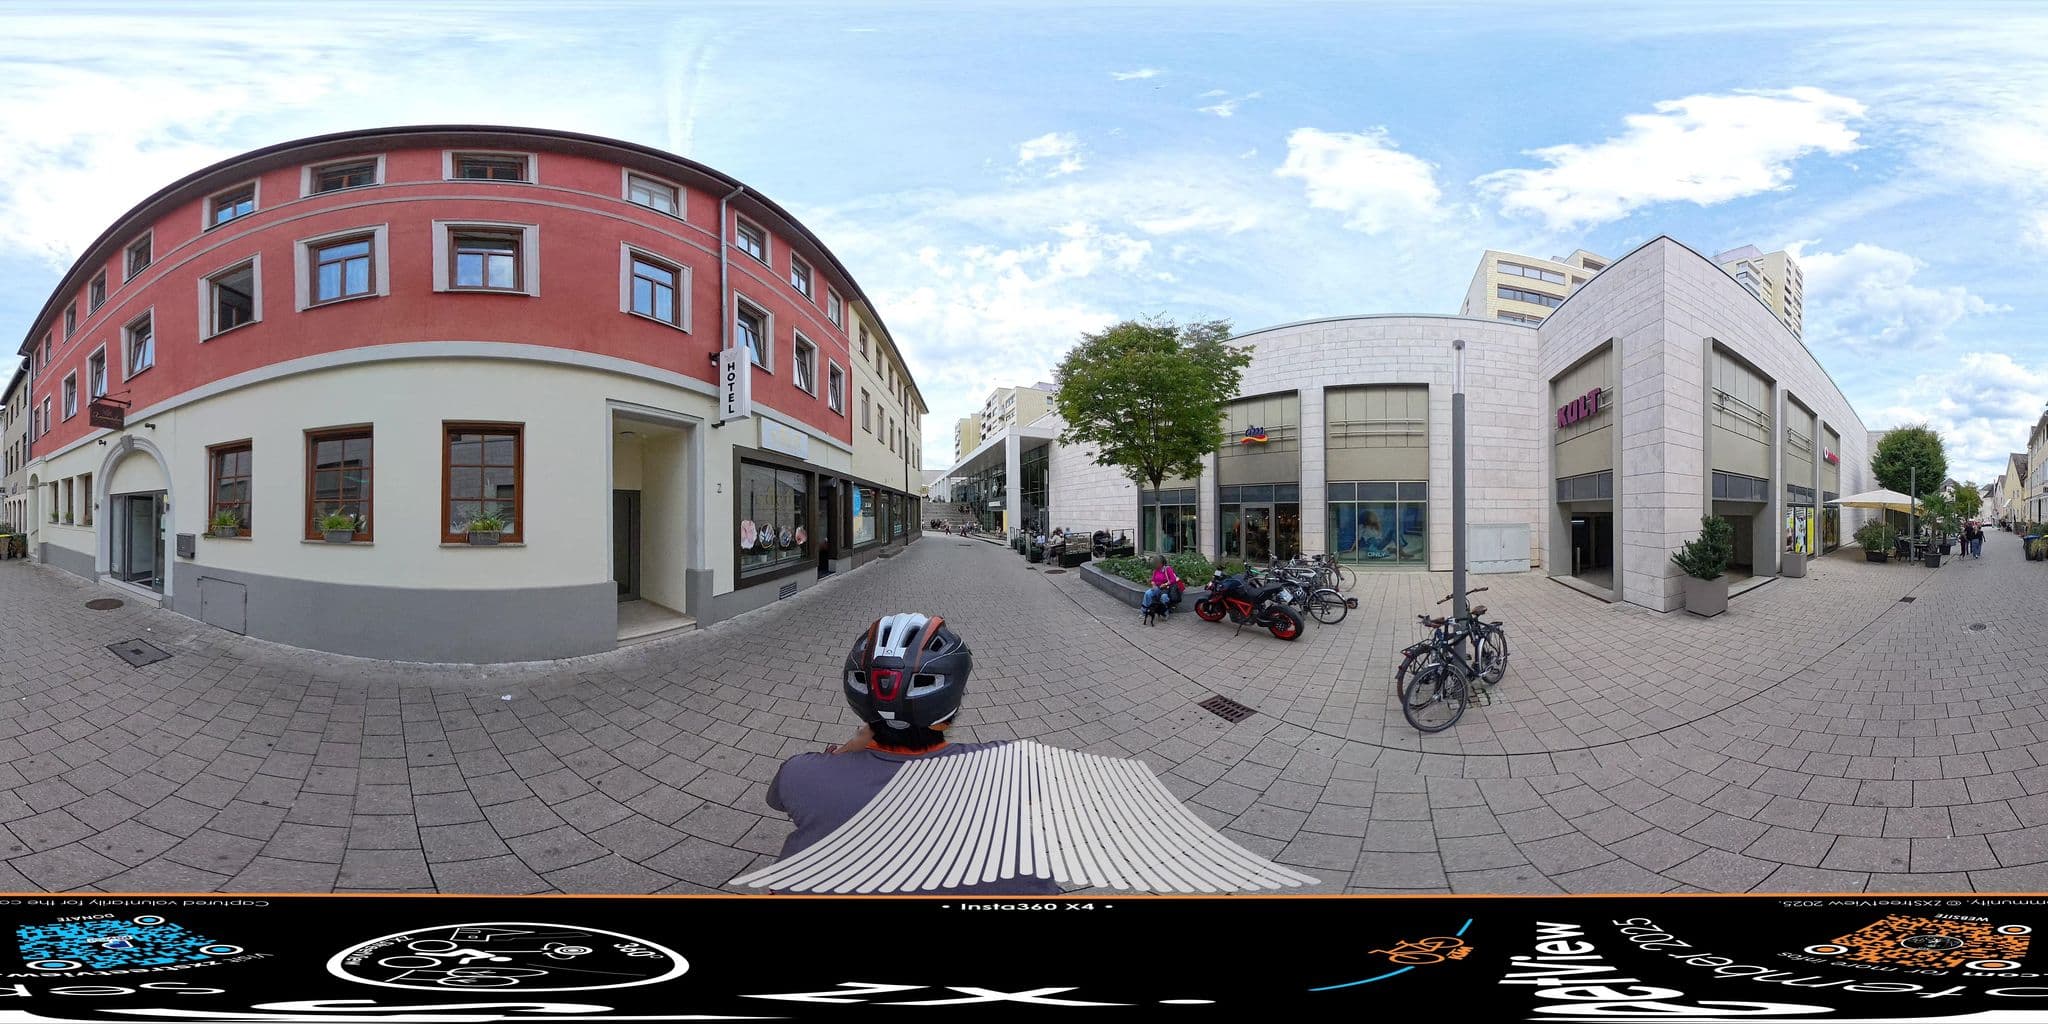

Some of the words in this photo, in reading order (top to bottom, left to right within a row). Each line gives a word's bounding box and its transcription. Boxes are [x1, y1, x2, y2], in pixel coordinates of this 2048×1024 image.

[727, 361, 736, 414] HOTEL
[1557, 387, 1601, 428] KULT
[1245, 424, 1264, 437] dm
